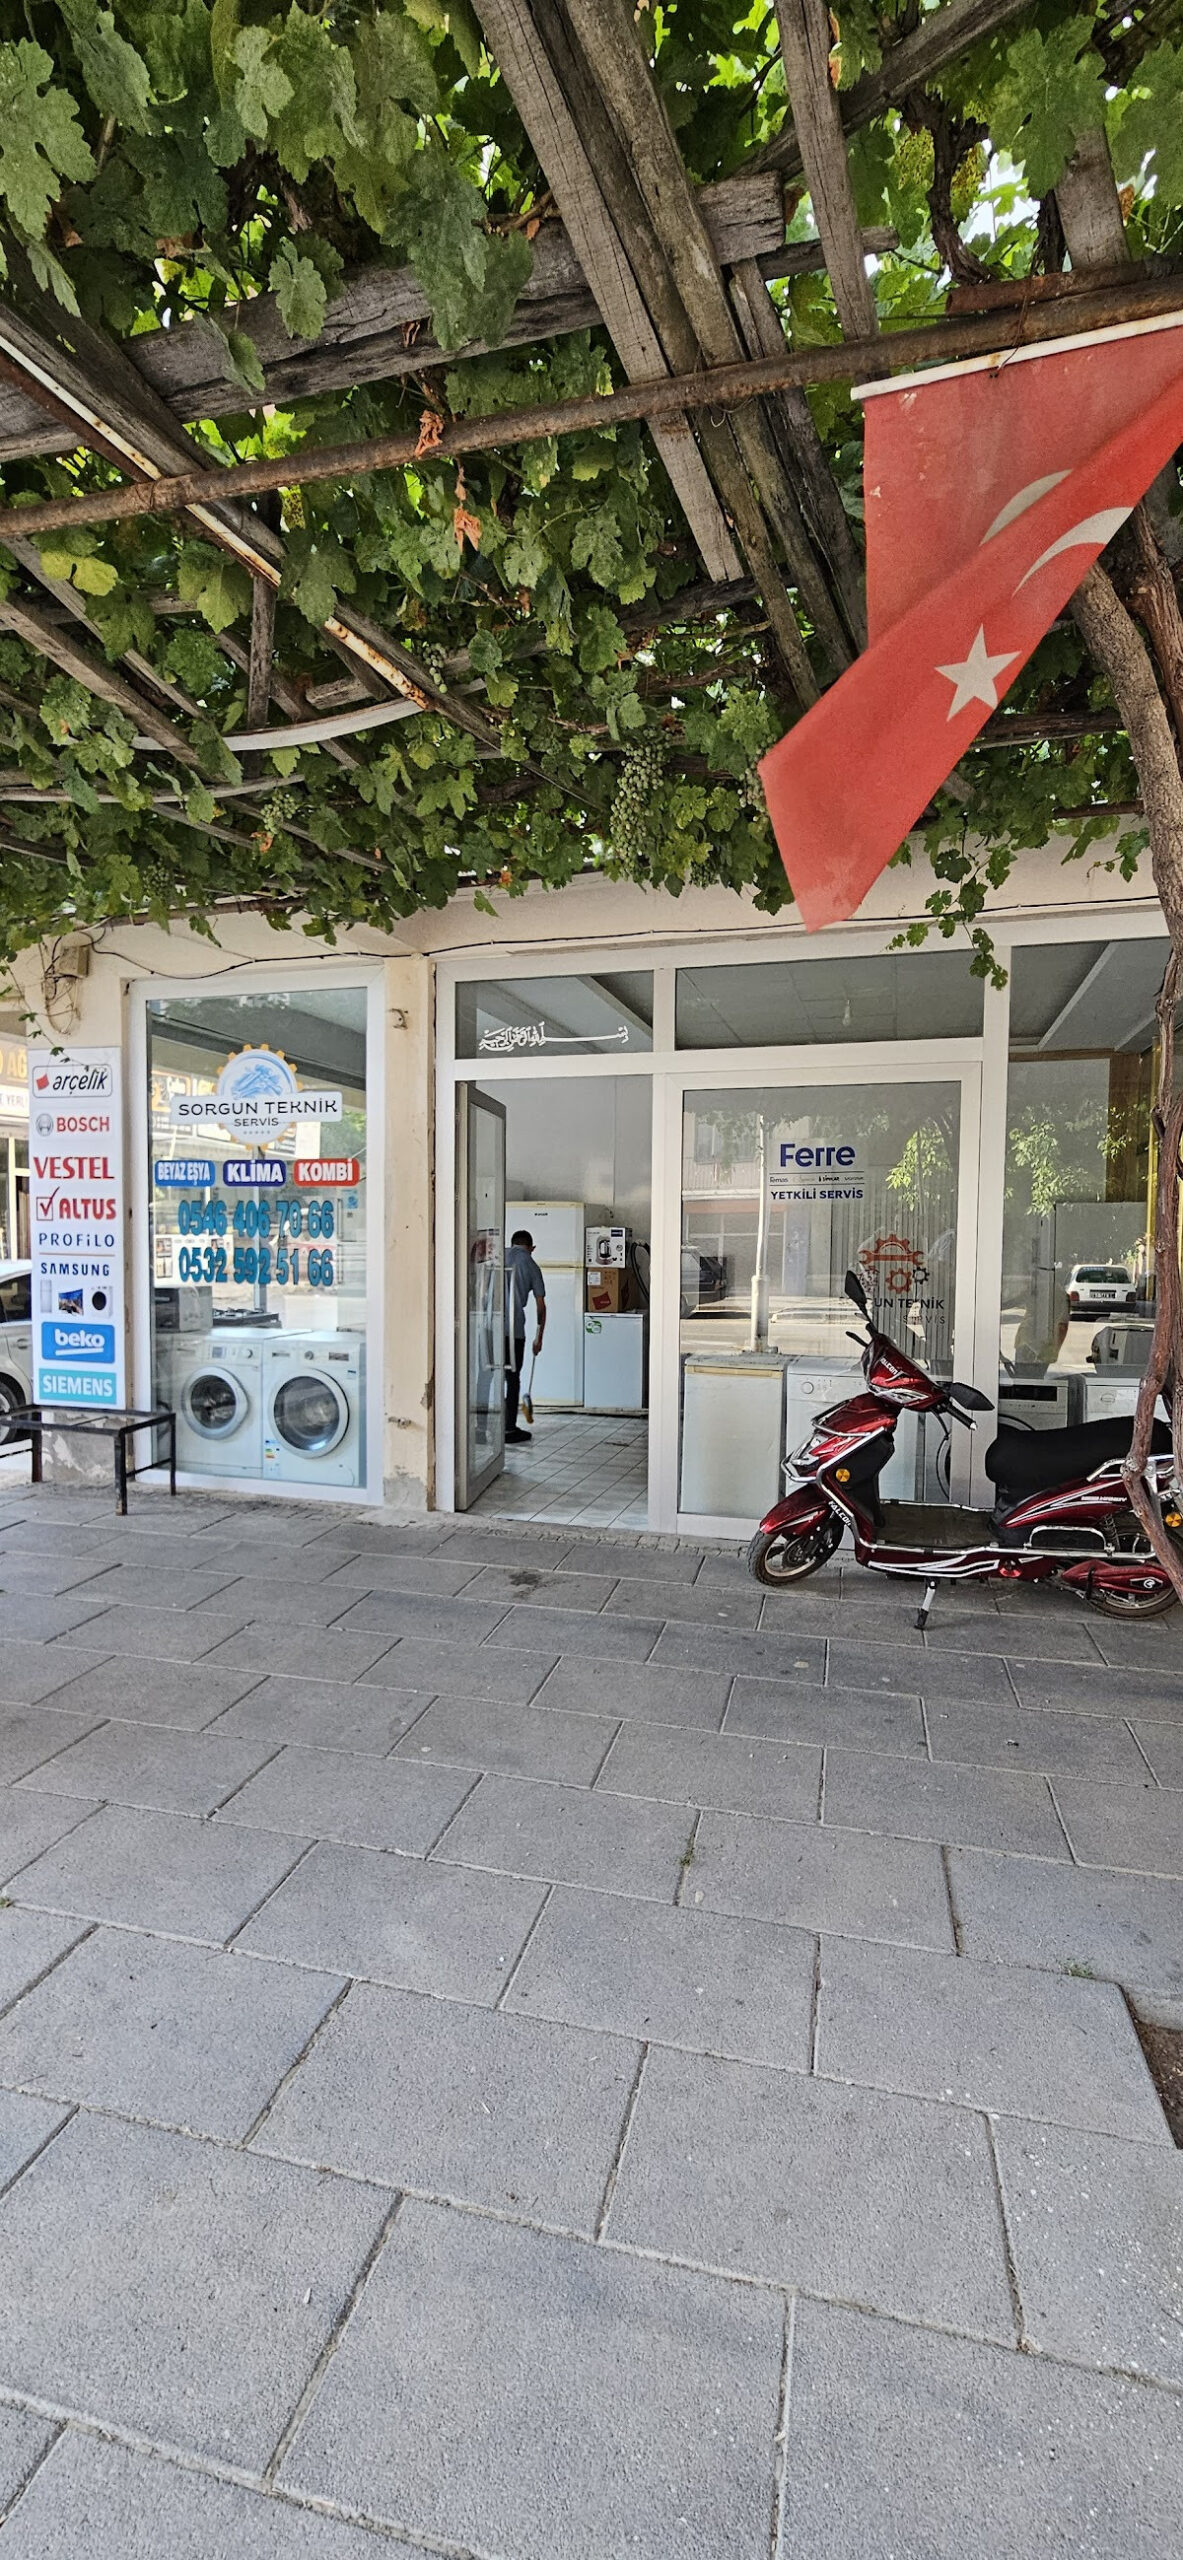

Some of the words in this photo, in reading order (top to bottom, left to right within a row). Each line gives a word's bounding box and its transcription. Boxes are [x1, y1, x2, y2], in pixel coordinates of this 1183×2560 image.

[52, 1069, 109, 1094] arçelik
[178, 1101, 258, 1116] SORGUN
[265, 1098, 338, 1114] TEKNİK
[56, 1116, 110, 1132] BOSCH
[234, 1116, 279, 1127] SERVİS
[780, 1143, 856, 1168] Ferre
[33, 1156, 115, 1179] VESTEL
[158, 1161, 187, 1181] BEYAZ
[187, 1161, 210, 1186] EŞYA
[227, 1160, 284, 1183] KLİMA
[298, 1158, 353, 1182] KOMBİ
[771, 1187, 817, 1200] YETKİLİ
[819, 1186, 864, 1199] SERVİS
[59, 1198, 117, 1220] ALTUS
[177, 1199, 228, 1236] 0546
[233, 1199, 271, 1238] 406
[275, 1200, 302, 1238] 70
[307, 1200, 335, 1239] 66
[41, 1262, 110, 1277] SAMSUNG
[178, 1246, 228, 1283] 0532
[233, 1246, 271, 1285] 592
[275, 1247, 300, 1285] 51
[307, 1248, 334, 1287] 66
[54, 1328, 105, 1348] beko
[42, 1374, 113, 1397] SIEMENS
